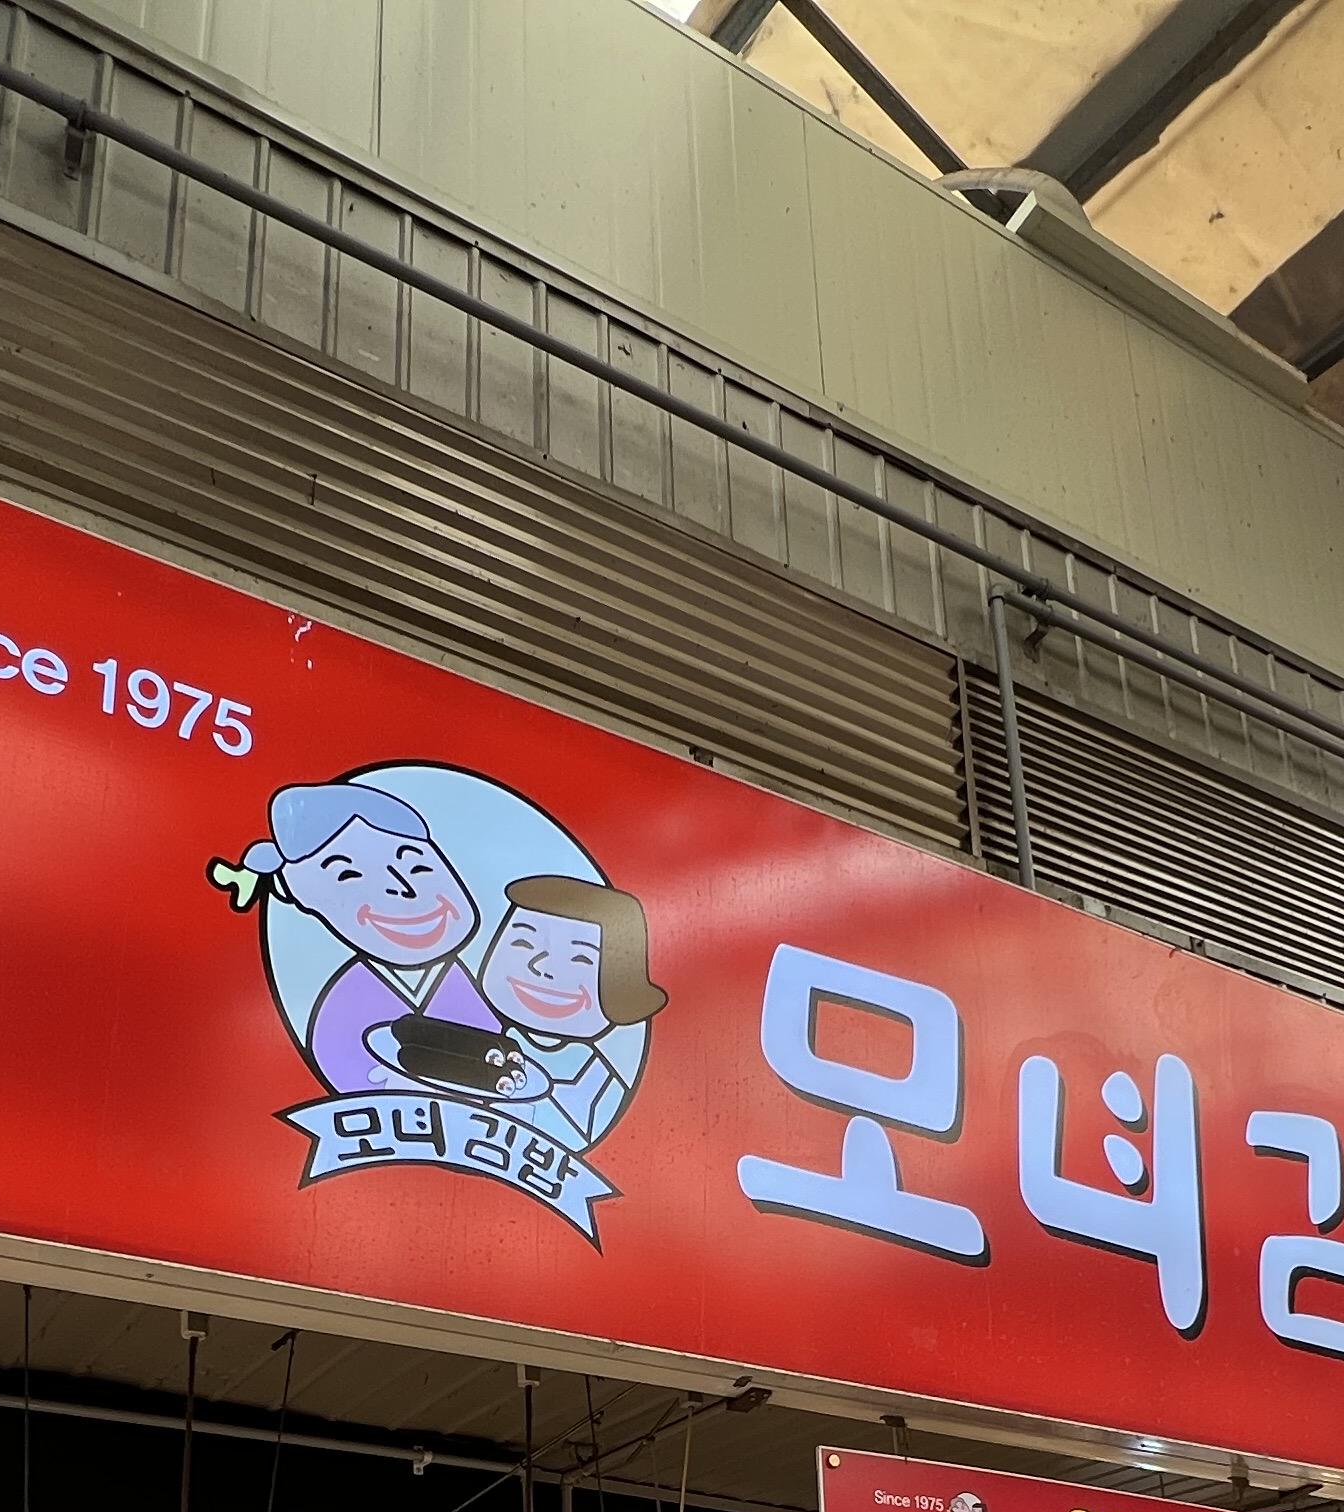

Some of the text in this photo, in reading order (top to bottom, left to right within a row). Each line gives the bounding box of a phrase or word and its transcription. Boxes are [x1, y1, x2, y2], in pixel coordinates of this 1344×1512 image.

[93, 659, 255, 757] 1975
[874, 1490, 945, 1512] Since 1975
